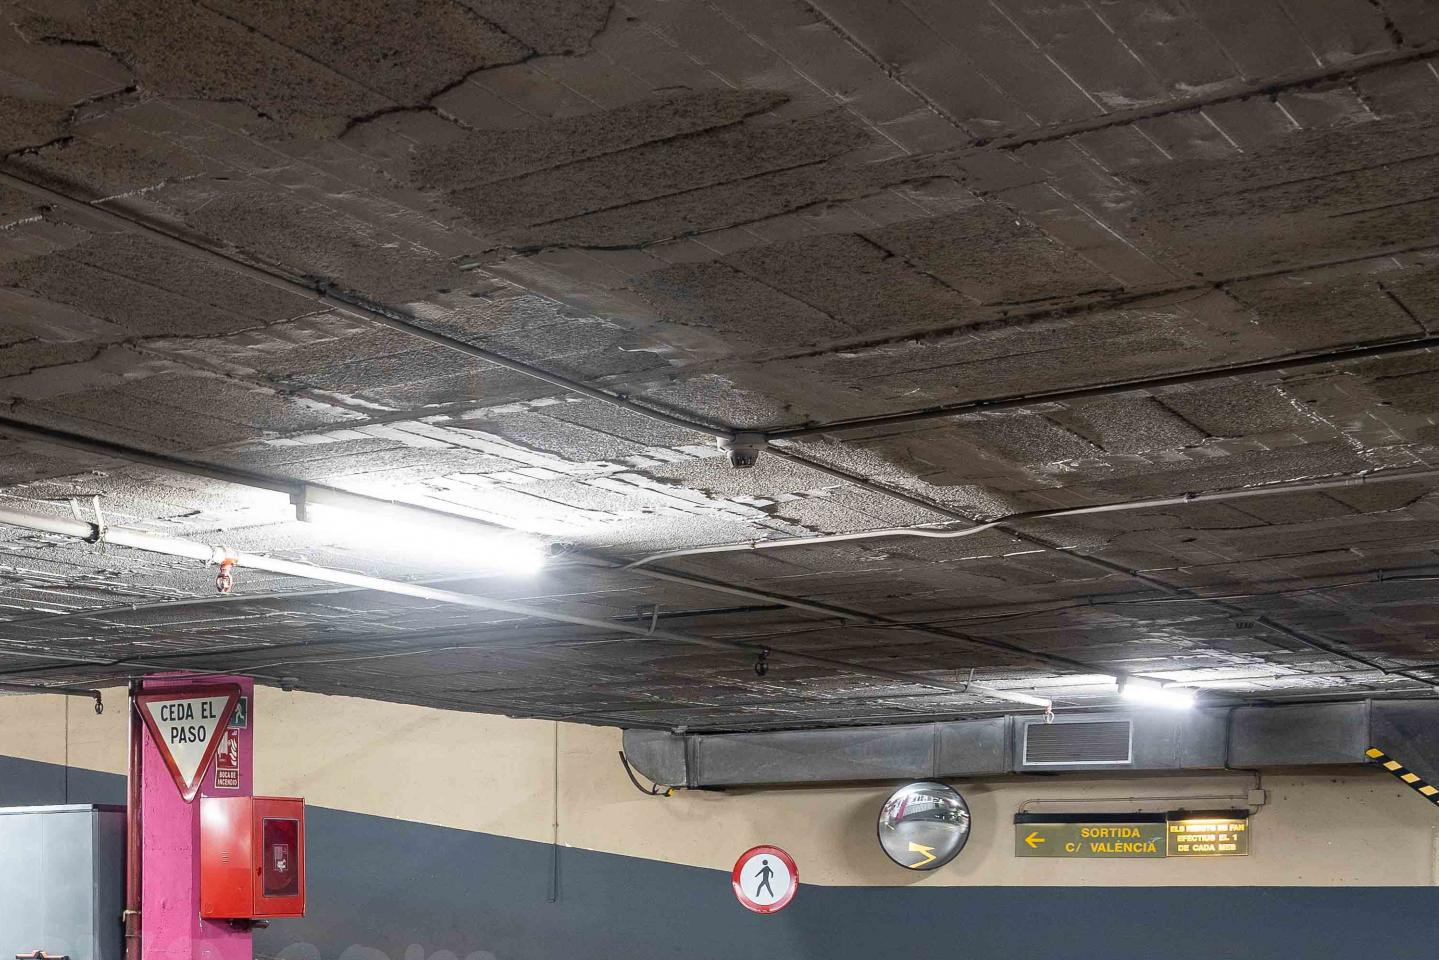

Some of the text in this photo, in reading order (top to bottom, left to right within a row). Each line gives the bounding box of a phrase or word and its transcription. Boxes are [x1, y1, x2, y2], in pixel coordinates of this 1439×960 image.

[161, 701, 216, 722] CEDA EL
[171, 726, 206, 744] PASO
[1081, 828, 1140, 838] SORTIDA
[1066, 839, 1157, 853] C/ VALÈNCIA
[1178, 844, 1189, 852] DE
[1192, 844, 1215, 852] CADA
